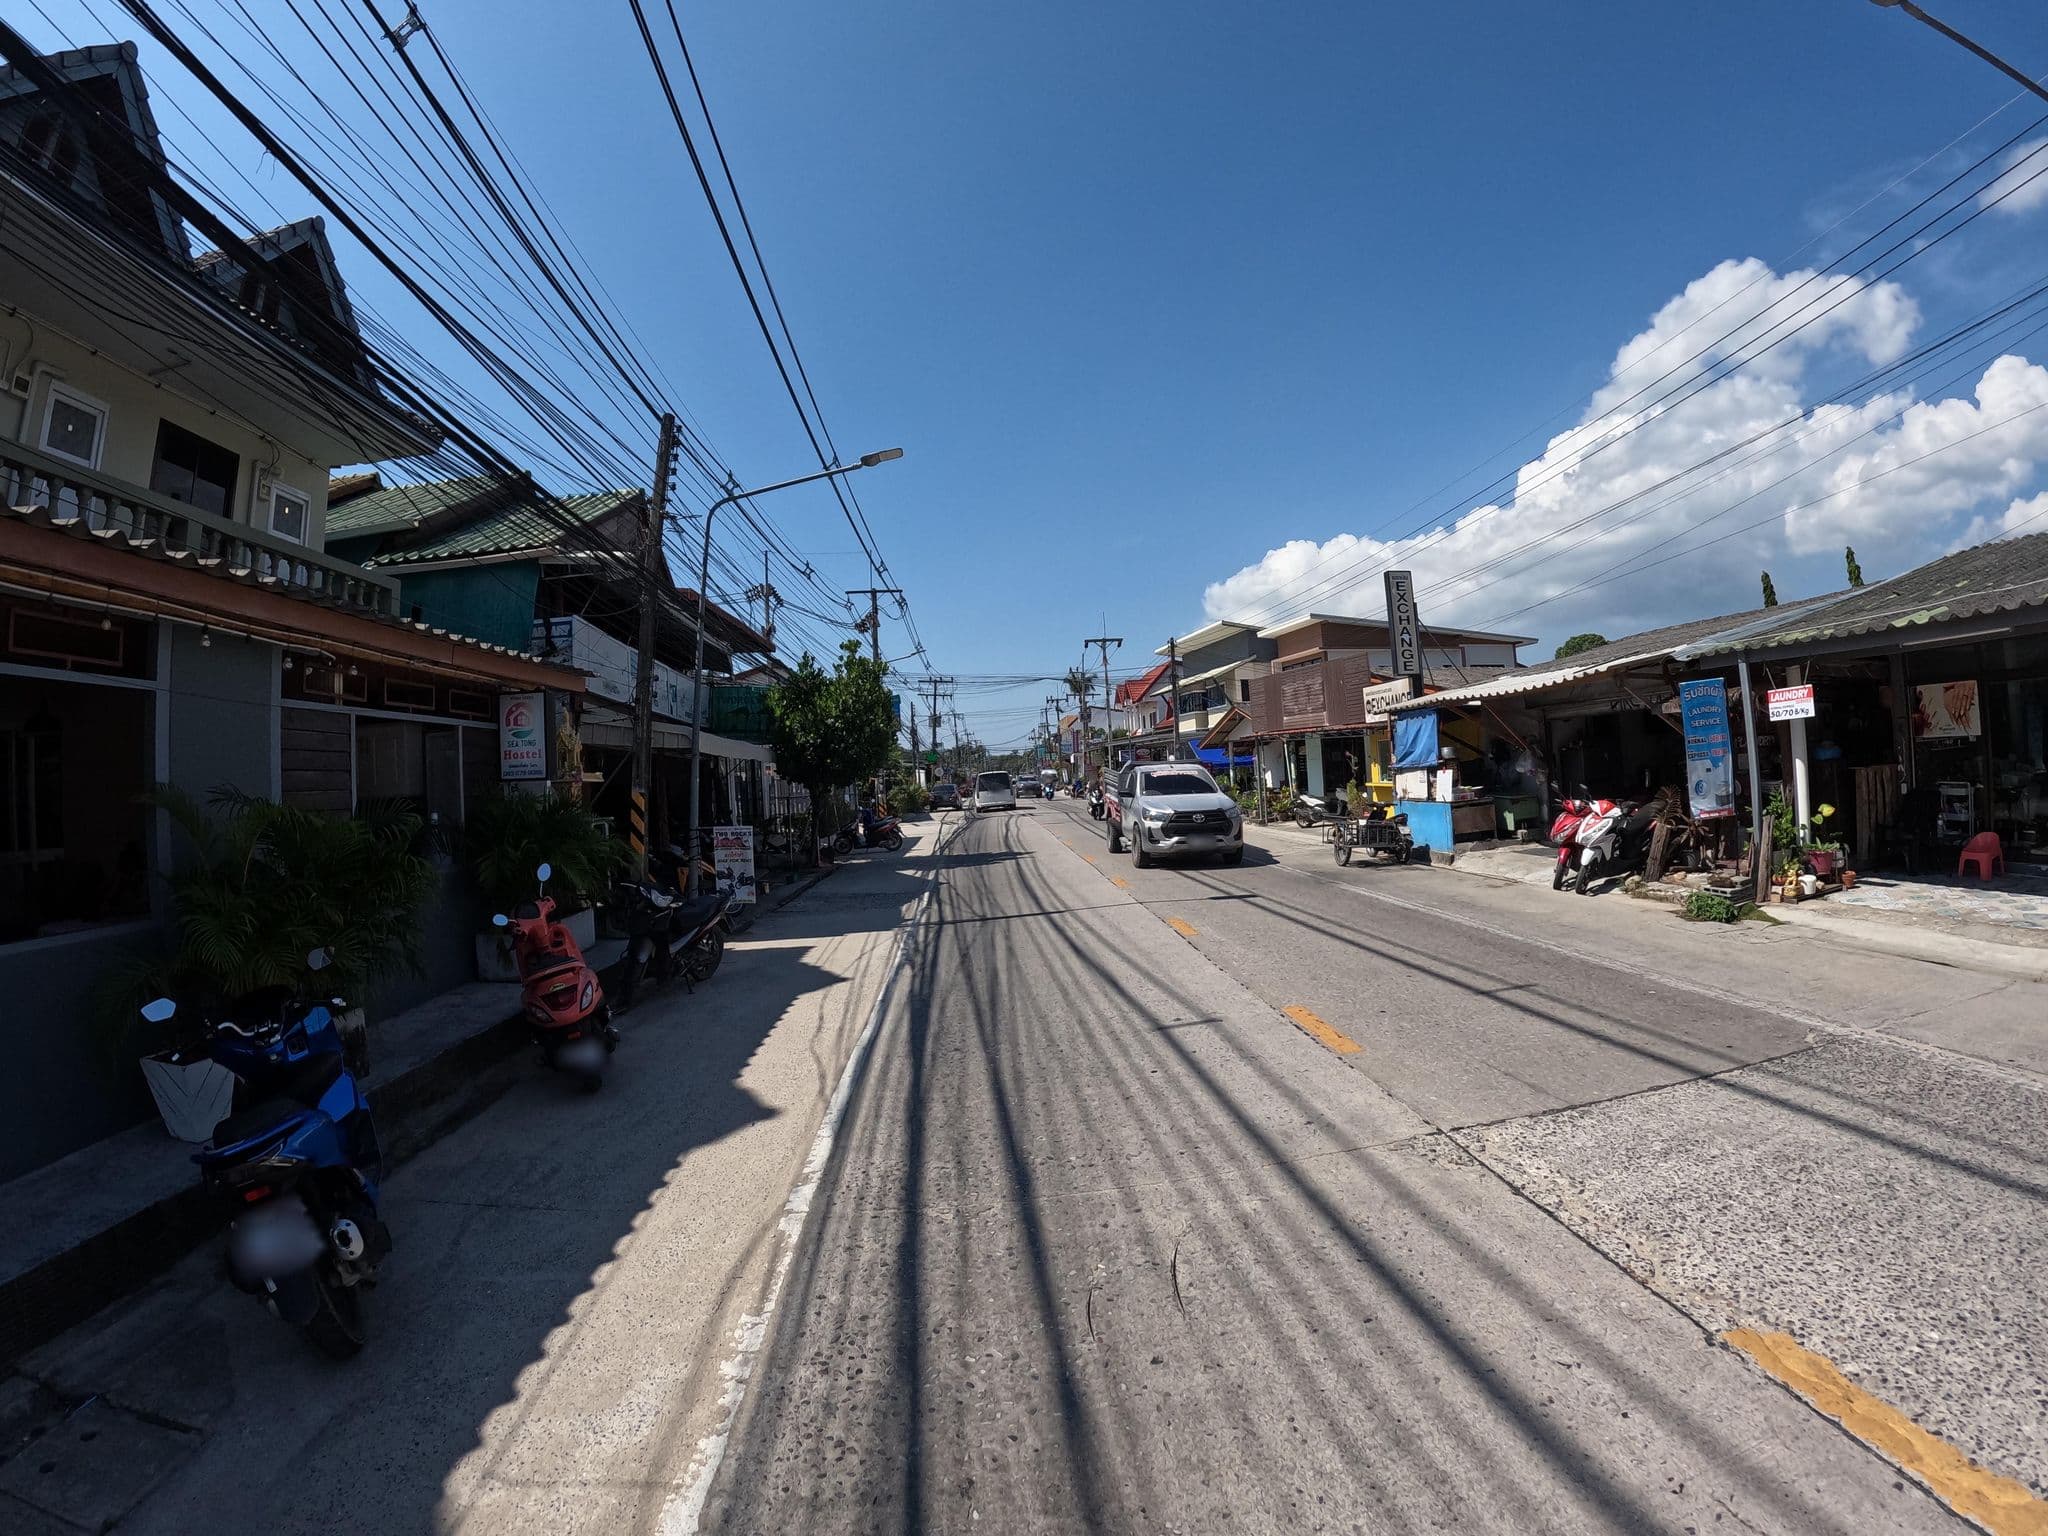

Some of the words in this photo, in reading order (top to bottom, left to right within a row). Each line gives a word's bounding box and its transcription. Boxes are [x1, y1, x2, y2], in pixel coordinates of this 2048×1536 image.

[1396, 581, 1414, 672] EXCHANGE
[1770, 689, 1808, 702] LAUNDRY
[1688, 705, 1721, 717] LAUNDRY
[1691, 717, 1721, 727] SERVICE
[503, 750, 542, 760] Hostel
